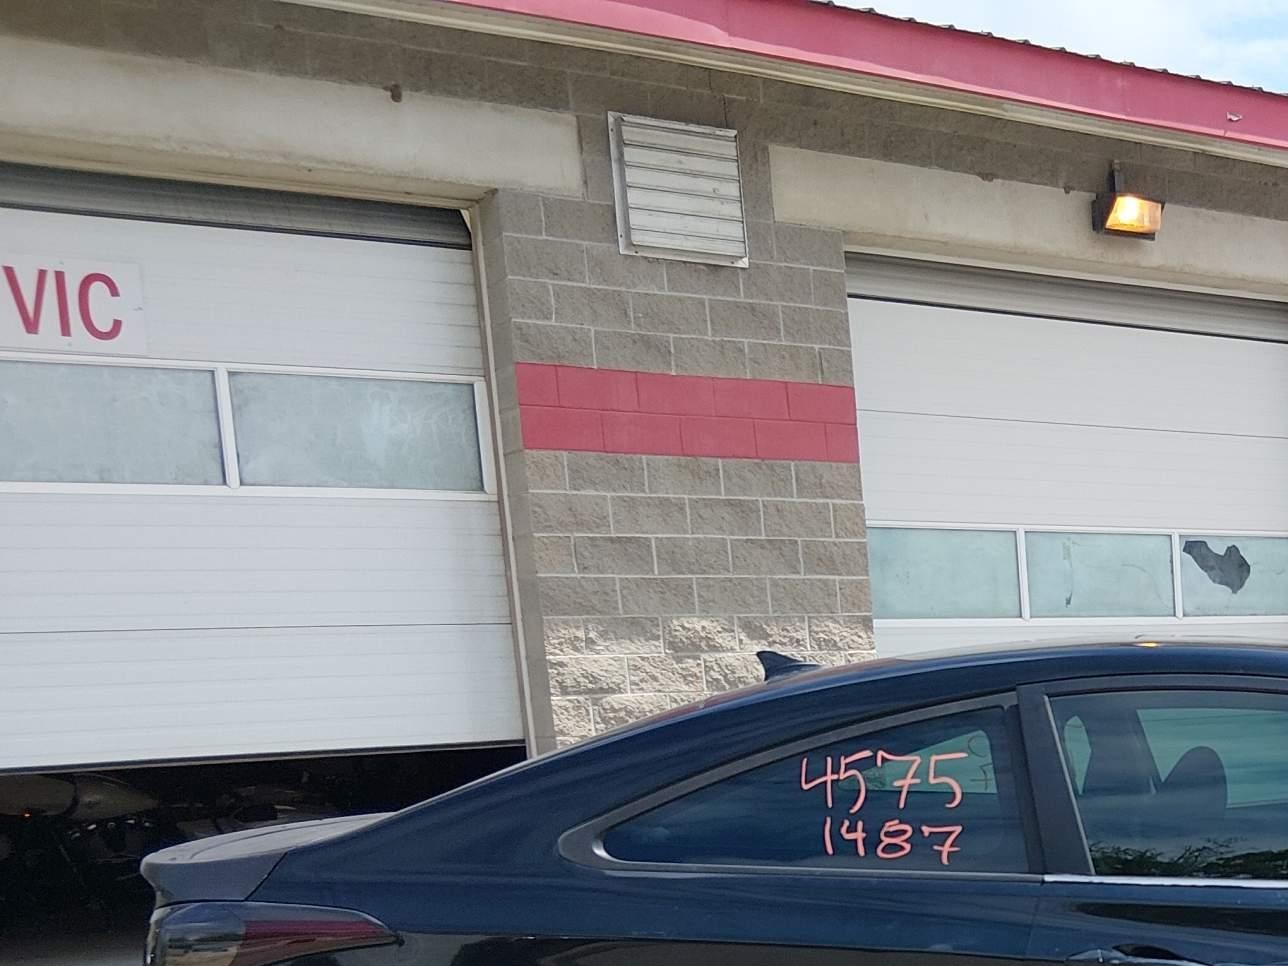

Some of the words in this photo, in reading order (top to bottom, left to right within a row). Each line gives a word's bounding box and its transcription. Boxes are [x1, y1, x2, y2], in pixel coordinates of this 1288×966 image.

[2, 265, 122, 341] VIC
[800, 750, 968, 814] 4575
[823, 817, 963, 865] 1487
